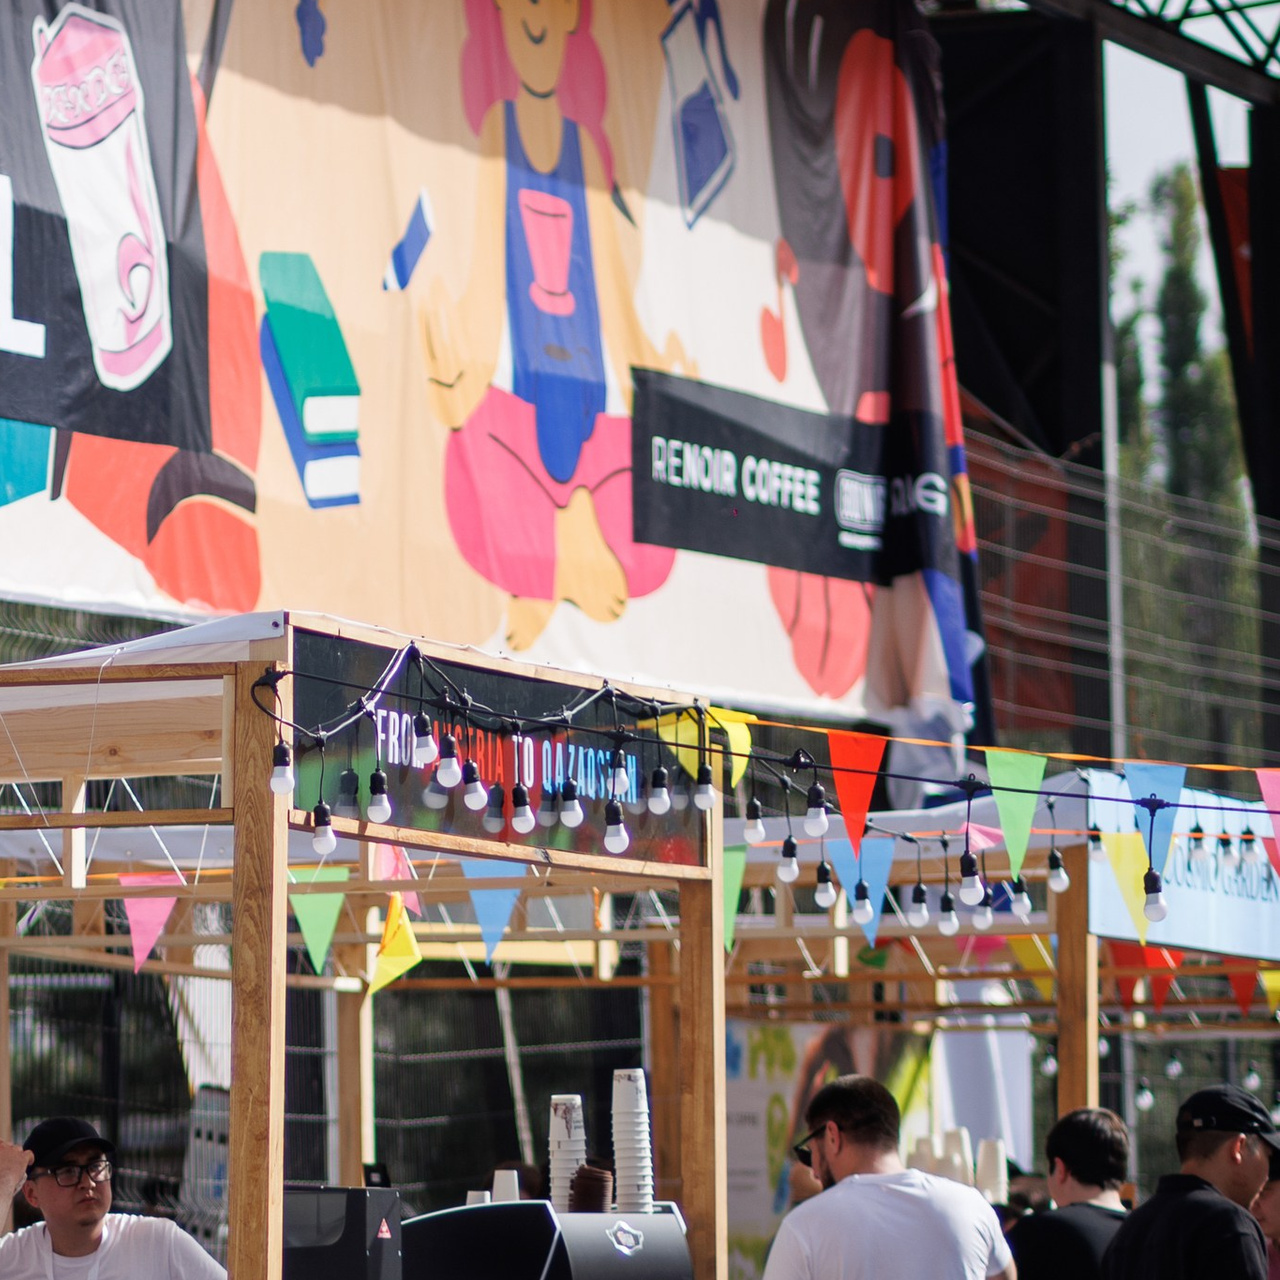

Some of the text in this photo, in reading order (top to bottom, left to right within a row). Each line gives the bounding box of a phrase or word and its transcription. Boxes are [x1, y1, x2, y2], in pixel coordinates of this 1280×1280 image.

[651, 436, 737, 497] RENOIR
[741, 455, 821, 516] COFFEE
[511, 734, 535, 789] TO
[542, 739, 638, 805] QAZAQSN
